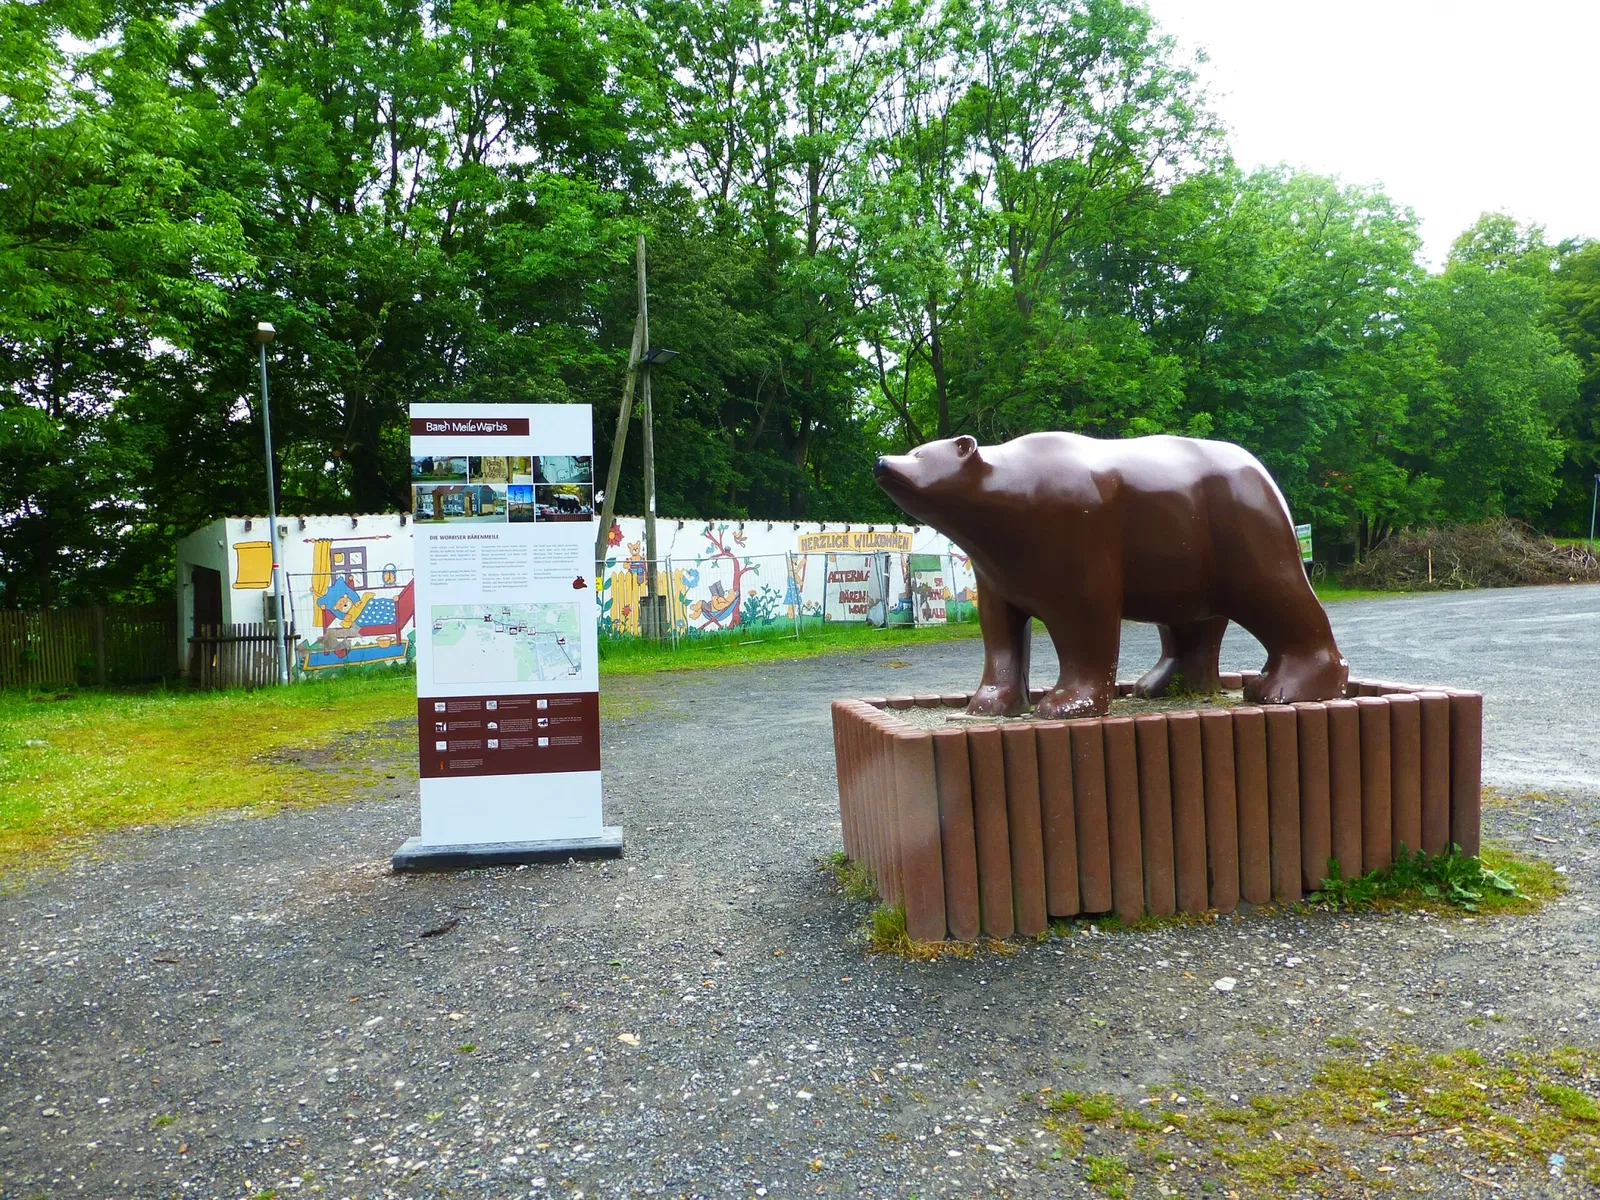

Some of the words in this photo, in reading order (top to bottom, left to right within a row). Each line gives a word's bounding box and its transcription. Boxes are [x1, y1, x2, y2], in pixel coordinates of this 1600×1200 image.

[452, 420, 476, 432] Meile
[476, 421, 508, 432] Worbis
[801, 535, 849, 552] HERZLICH
[853, 534, 910, 550] WILLKOMMEN
